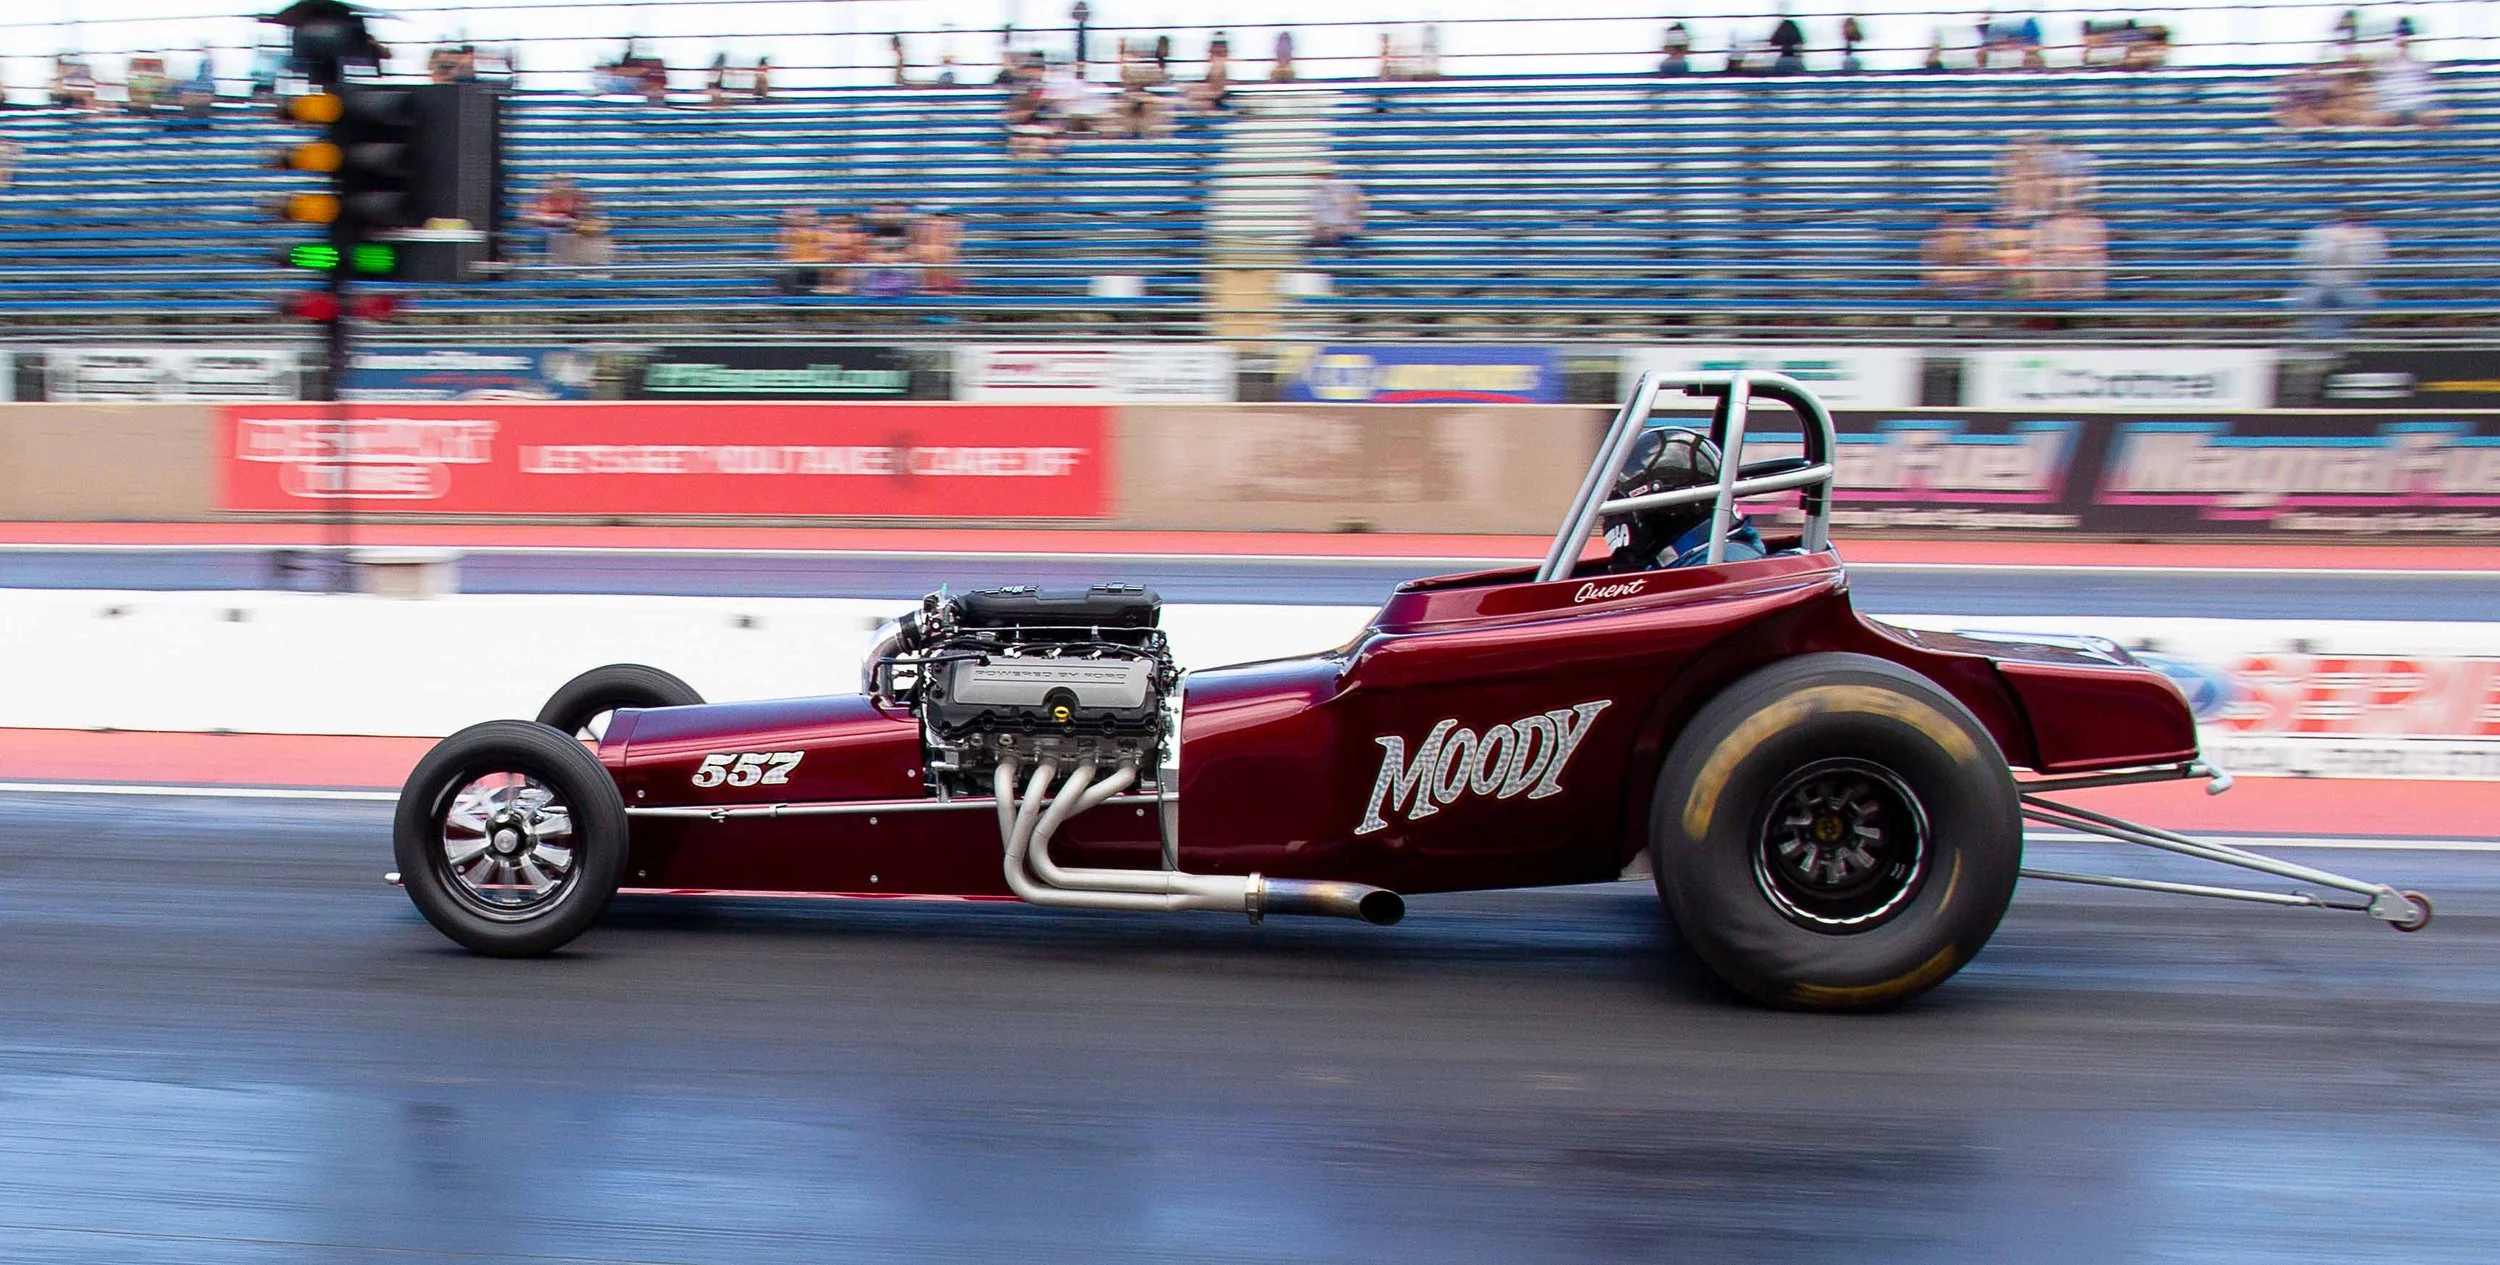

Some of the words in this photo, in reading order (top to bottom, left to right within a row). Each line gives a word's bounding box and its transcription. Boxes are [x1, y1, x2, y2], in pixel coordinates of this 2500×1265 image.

[1574, 578, 1647, 603] Quent
[975, 669, 1052, 678] POWERED
[691, 750, 805, 788] 557
[1354, 700, 1612, 835] MOODY
